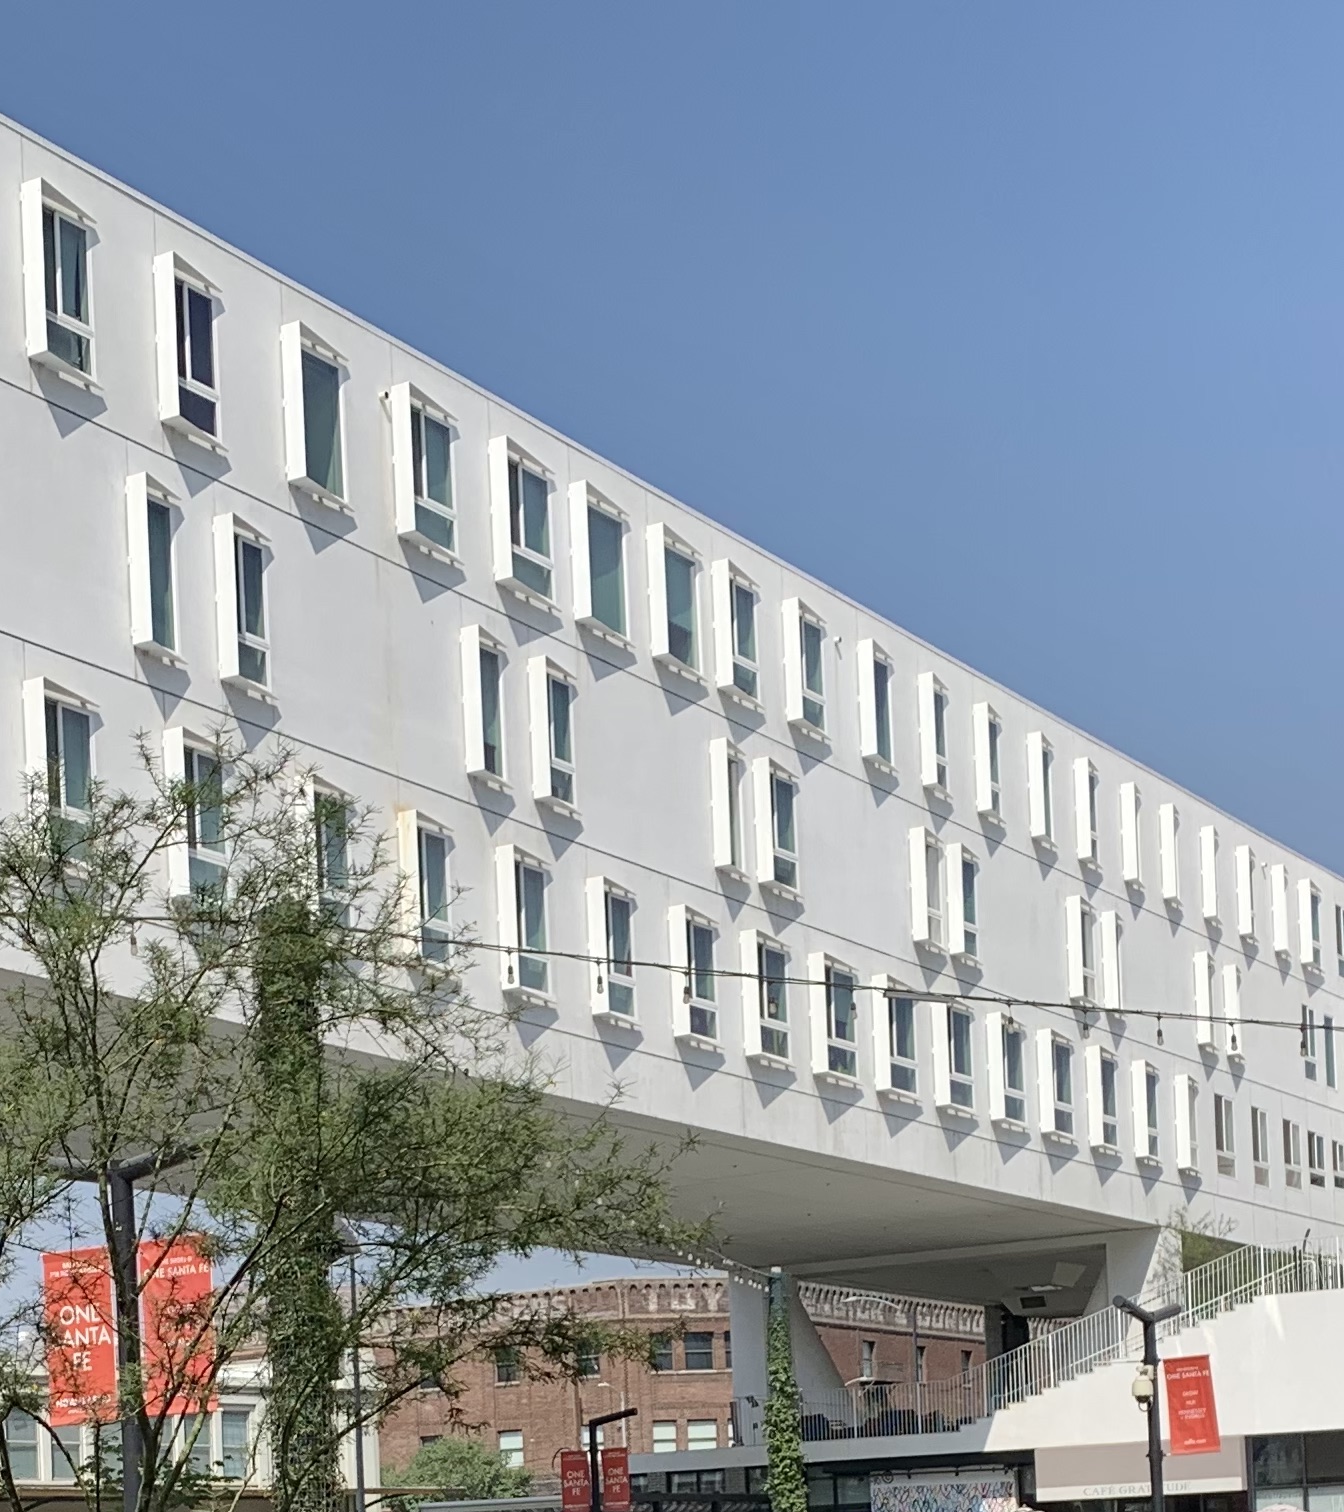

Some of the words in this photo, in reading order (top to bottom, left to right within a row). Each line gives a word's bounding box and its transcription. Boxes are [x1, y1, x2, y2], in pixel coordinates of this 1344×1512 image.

[55, 1326, 112, 1349] ANTA
[72, 1351, 93, 1372] FE
[566, 1470, 585, 1479] ONE
[563, 1479, 589, 1488] SANTA
